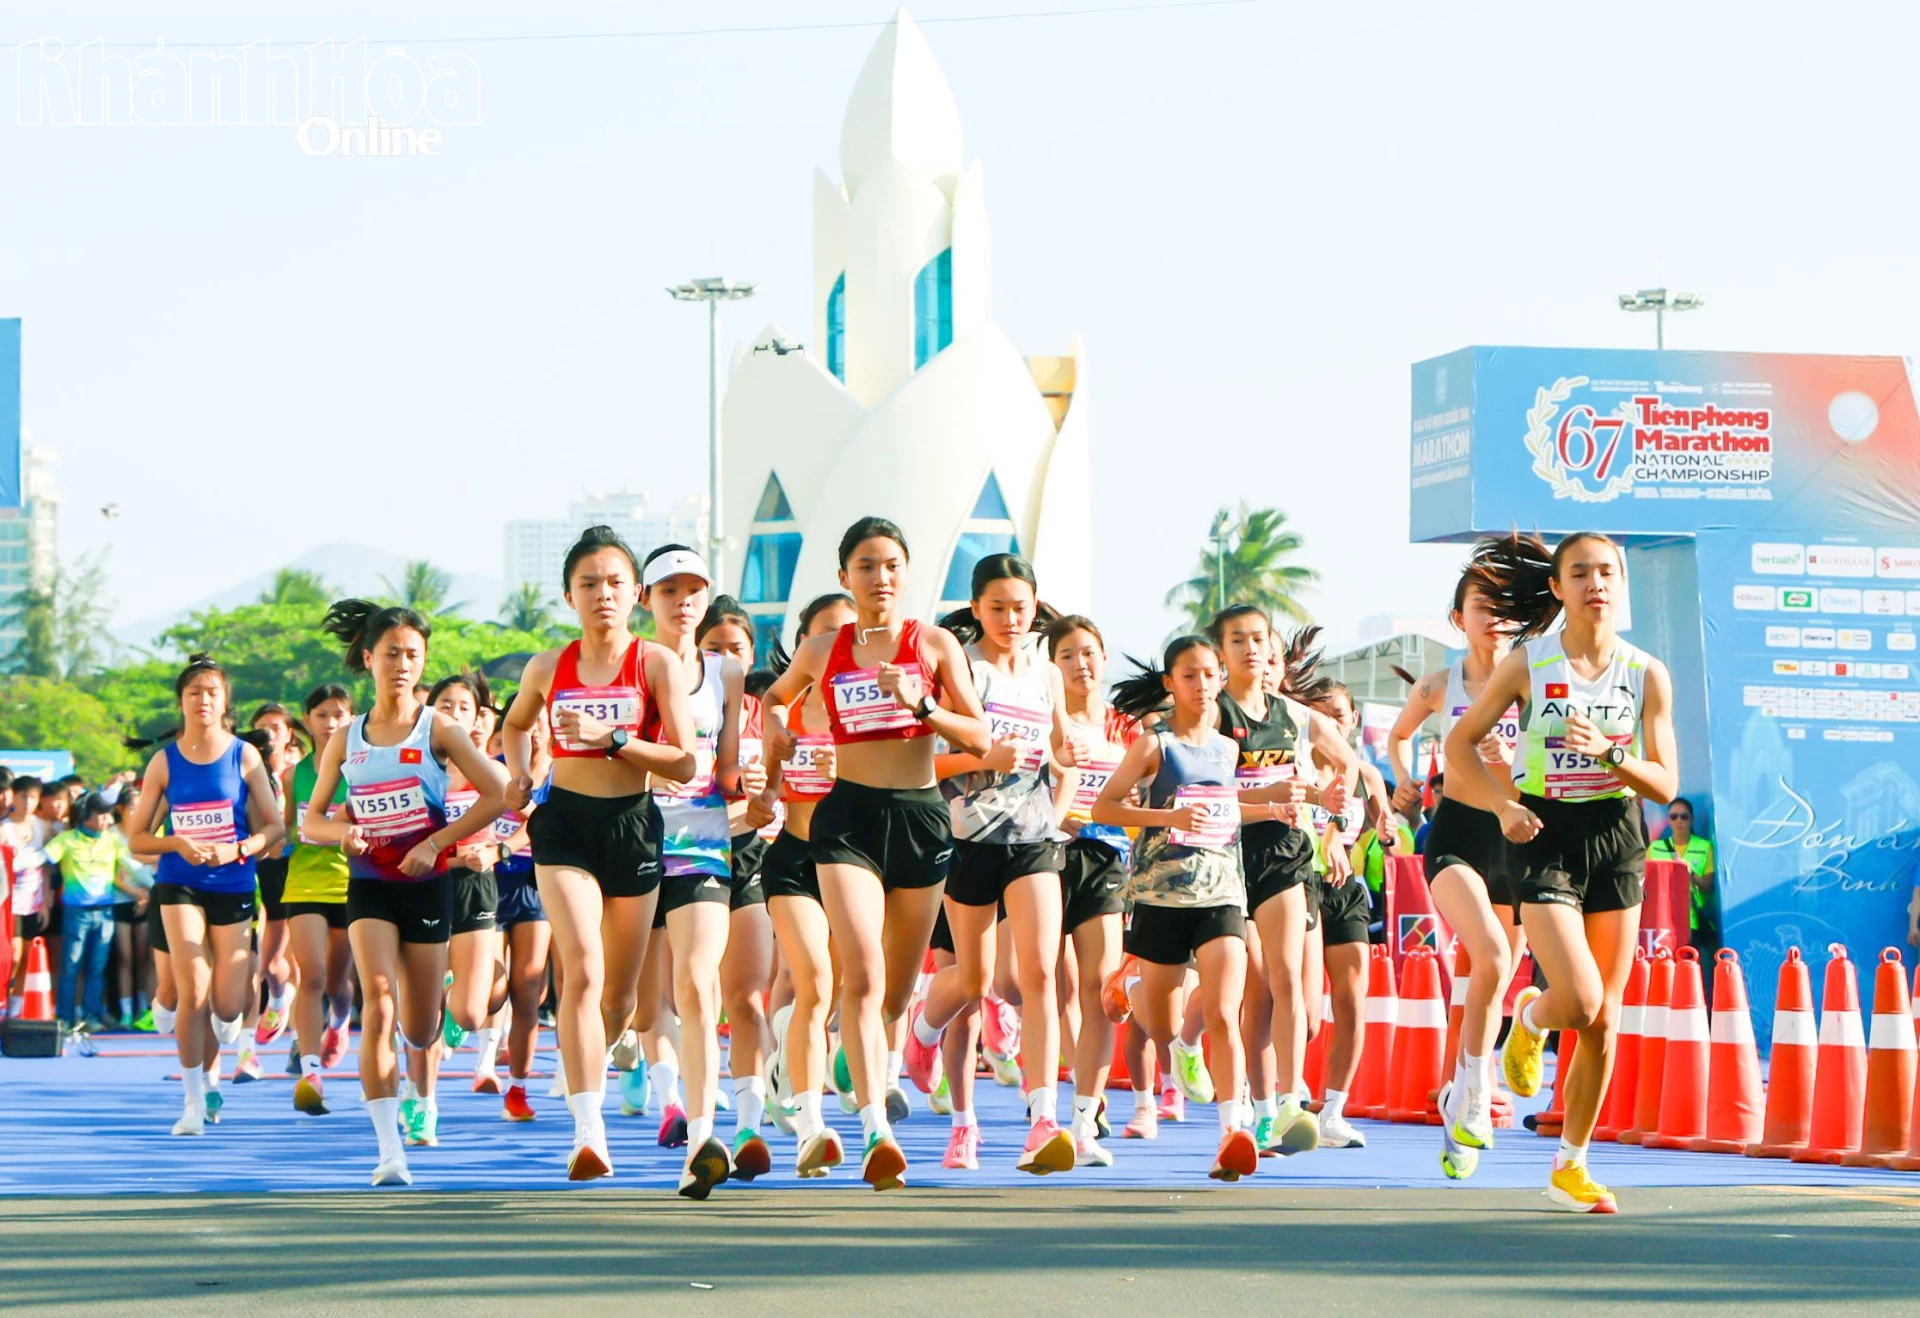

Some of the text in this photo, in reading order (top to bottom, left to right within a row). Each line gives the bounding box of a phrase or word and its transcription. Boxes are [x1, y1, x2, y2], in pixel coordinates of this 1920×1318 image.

[1413, 429, 1470, 467] MARATHON
[1558, 406, 1625, 479] 67
[1635, 430, 1770, 452] Marathon
[1635, 454, 1723, 466] NATIONAL
[1635, 467, 1770, 481] CHAMPIONSHIP
[1756, 555, 1798, 566] Herbalife
[1540, 701, 1636, 721] ANTA
[990, 717, 1040, 742] Y5529
[789, 750, 816, 766] Y55
[1551, 752, 1602, 769] Y554
[1078, 773, 1107, 788] 527
[357, 793, 411, 815] Y5515
[176, 812, 223, 827] Y5508
[1311, 806, 1355, 822] Y53
[494, 819, 519, 835] Y55
